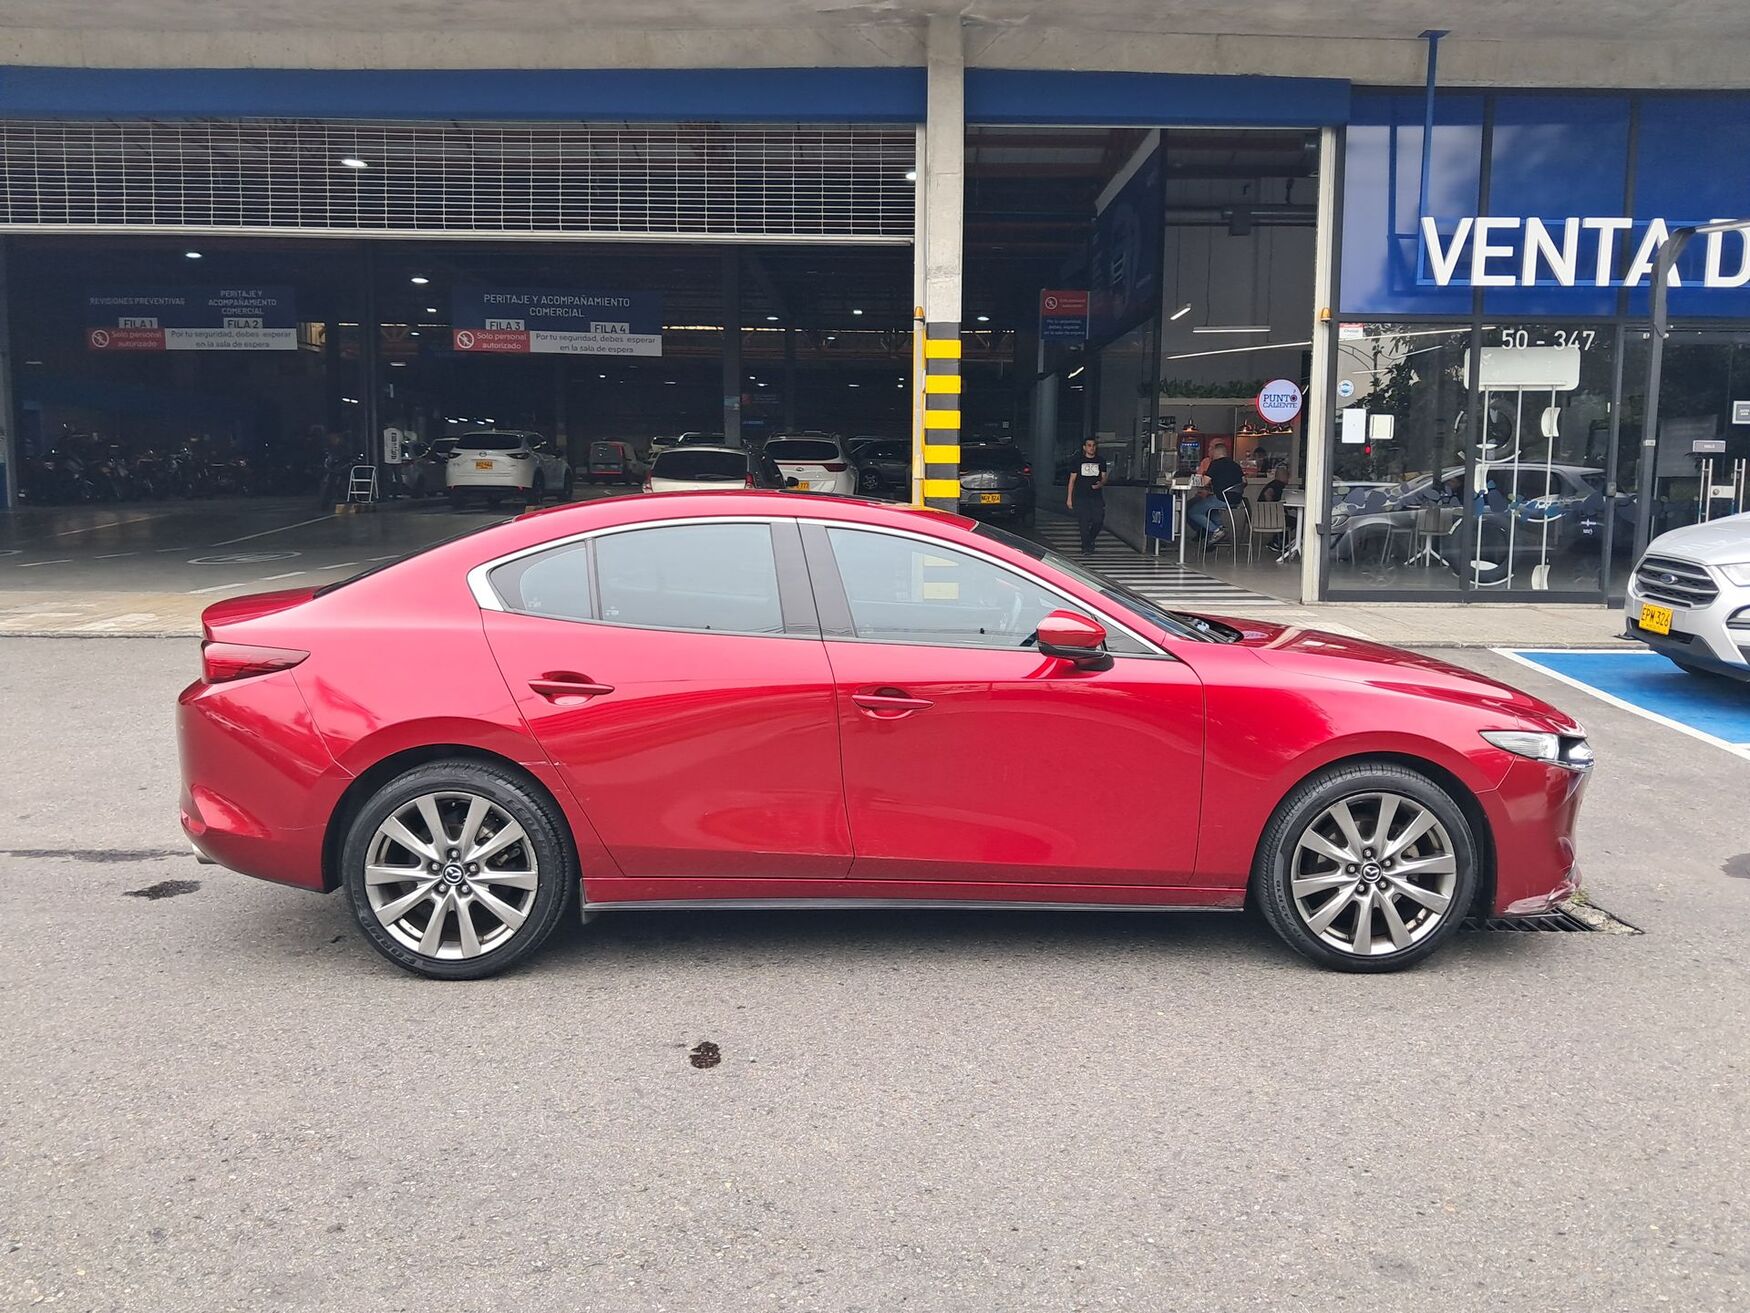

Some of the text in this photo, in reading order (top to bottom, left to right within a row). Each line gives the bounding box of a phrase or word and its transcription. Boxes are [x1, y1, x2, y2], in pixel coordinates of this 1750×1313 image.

[1421, 216, 1682, 287] VENTA
[220, 290, 257, 298] PERITAJE
[135, 297, 185, 305] PREVENTIVAS
[484, 294, 630, 307] PERITAJE Y ACOMPAÑAMIENTO
[221, 307, 264, 315] COMERCIAL
[529, 307, 585, 317] COMERCIAL
[124, 319, 147, 328] FILA
[227, 320, 259, 328] FILA 2
[489, 321, 521, 330] FILA 3
[594, 324, 626, 333] FILA 4
[477, 332, 527, 341] Solo personal
[626, 337, 656, 345] esperar
[1501, 330, 1528, 350] 50
[1553, 330, 1596, 351] 347
[482, 341, 522, 349] autorizado
[580, 344, 595, 352] sala
[607, 346, 634, 355] espera
[1263, 394, 1298, 403] PUNTO
